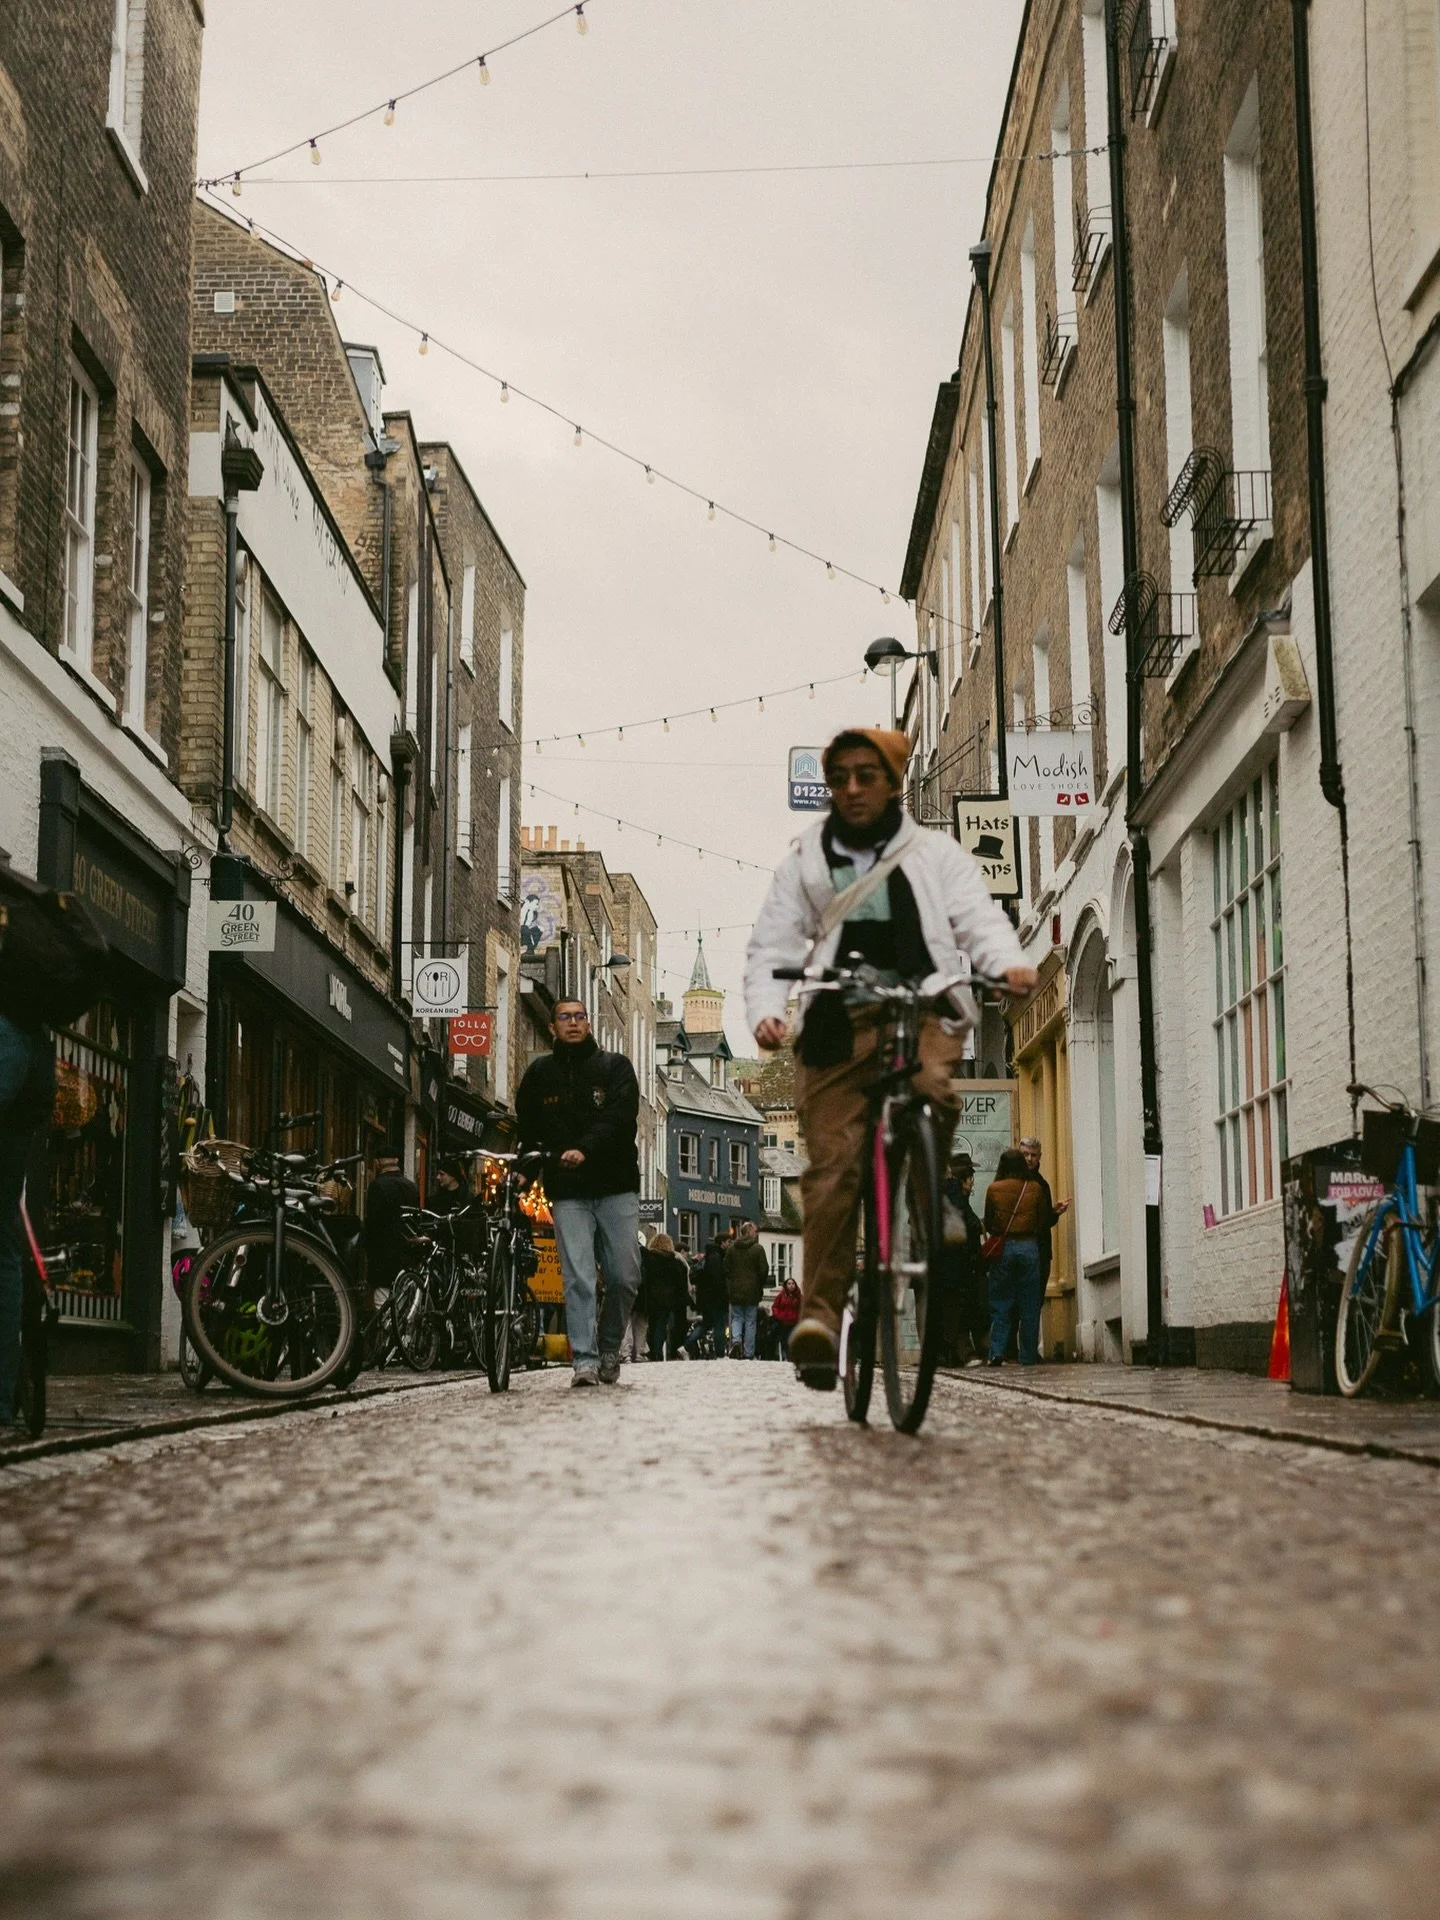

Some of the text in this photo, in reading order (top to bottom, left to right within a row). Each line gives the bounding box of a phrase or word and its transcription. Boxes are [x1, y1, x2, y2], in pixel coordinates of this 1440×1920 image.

[1013, 751, 1088, 779] Modish
[794, 785, 832, 798] 01223
[1013, 782, 1089, 791] LOVE SHOES
[966, 815, 1009, 831] Hats
[981, 863, 1012, 879] aps
[228, 904, 255, 921] 40
[221, 922, 260, 935] GREEN
[220, 932, 260, 947] STREET
[444, 1007, 459, 1015] BBQ
[453, 1019, 488, 1029] IOLLA
[962, 1096, 996, 1112] VER
[959, 1114, 988, 1125] TREET
[638, 1203, 662, 1211] NOOPS
